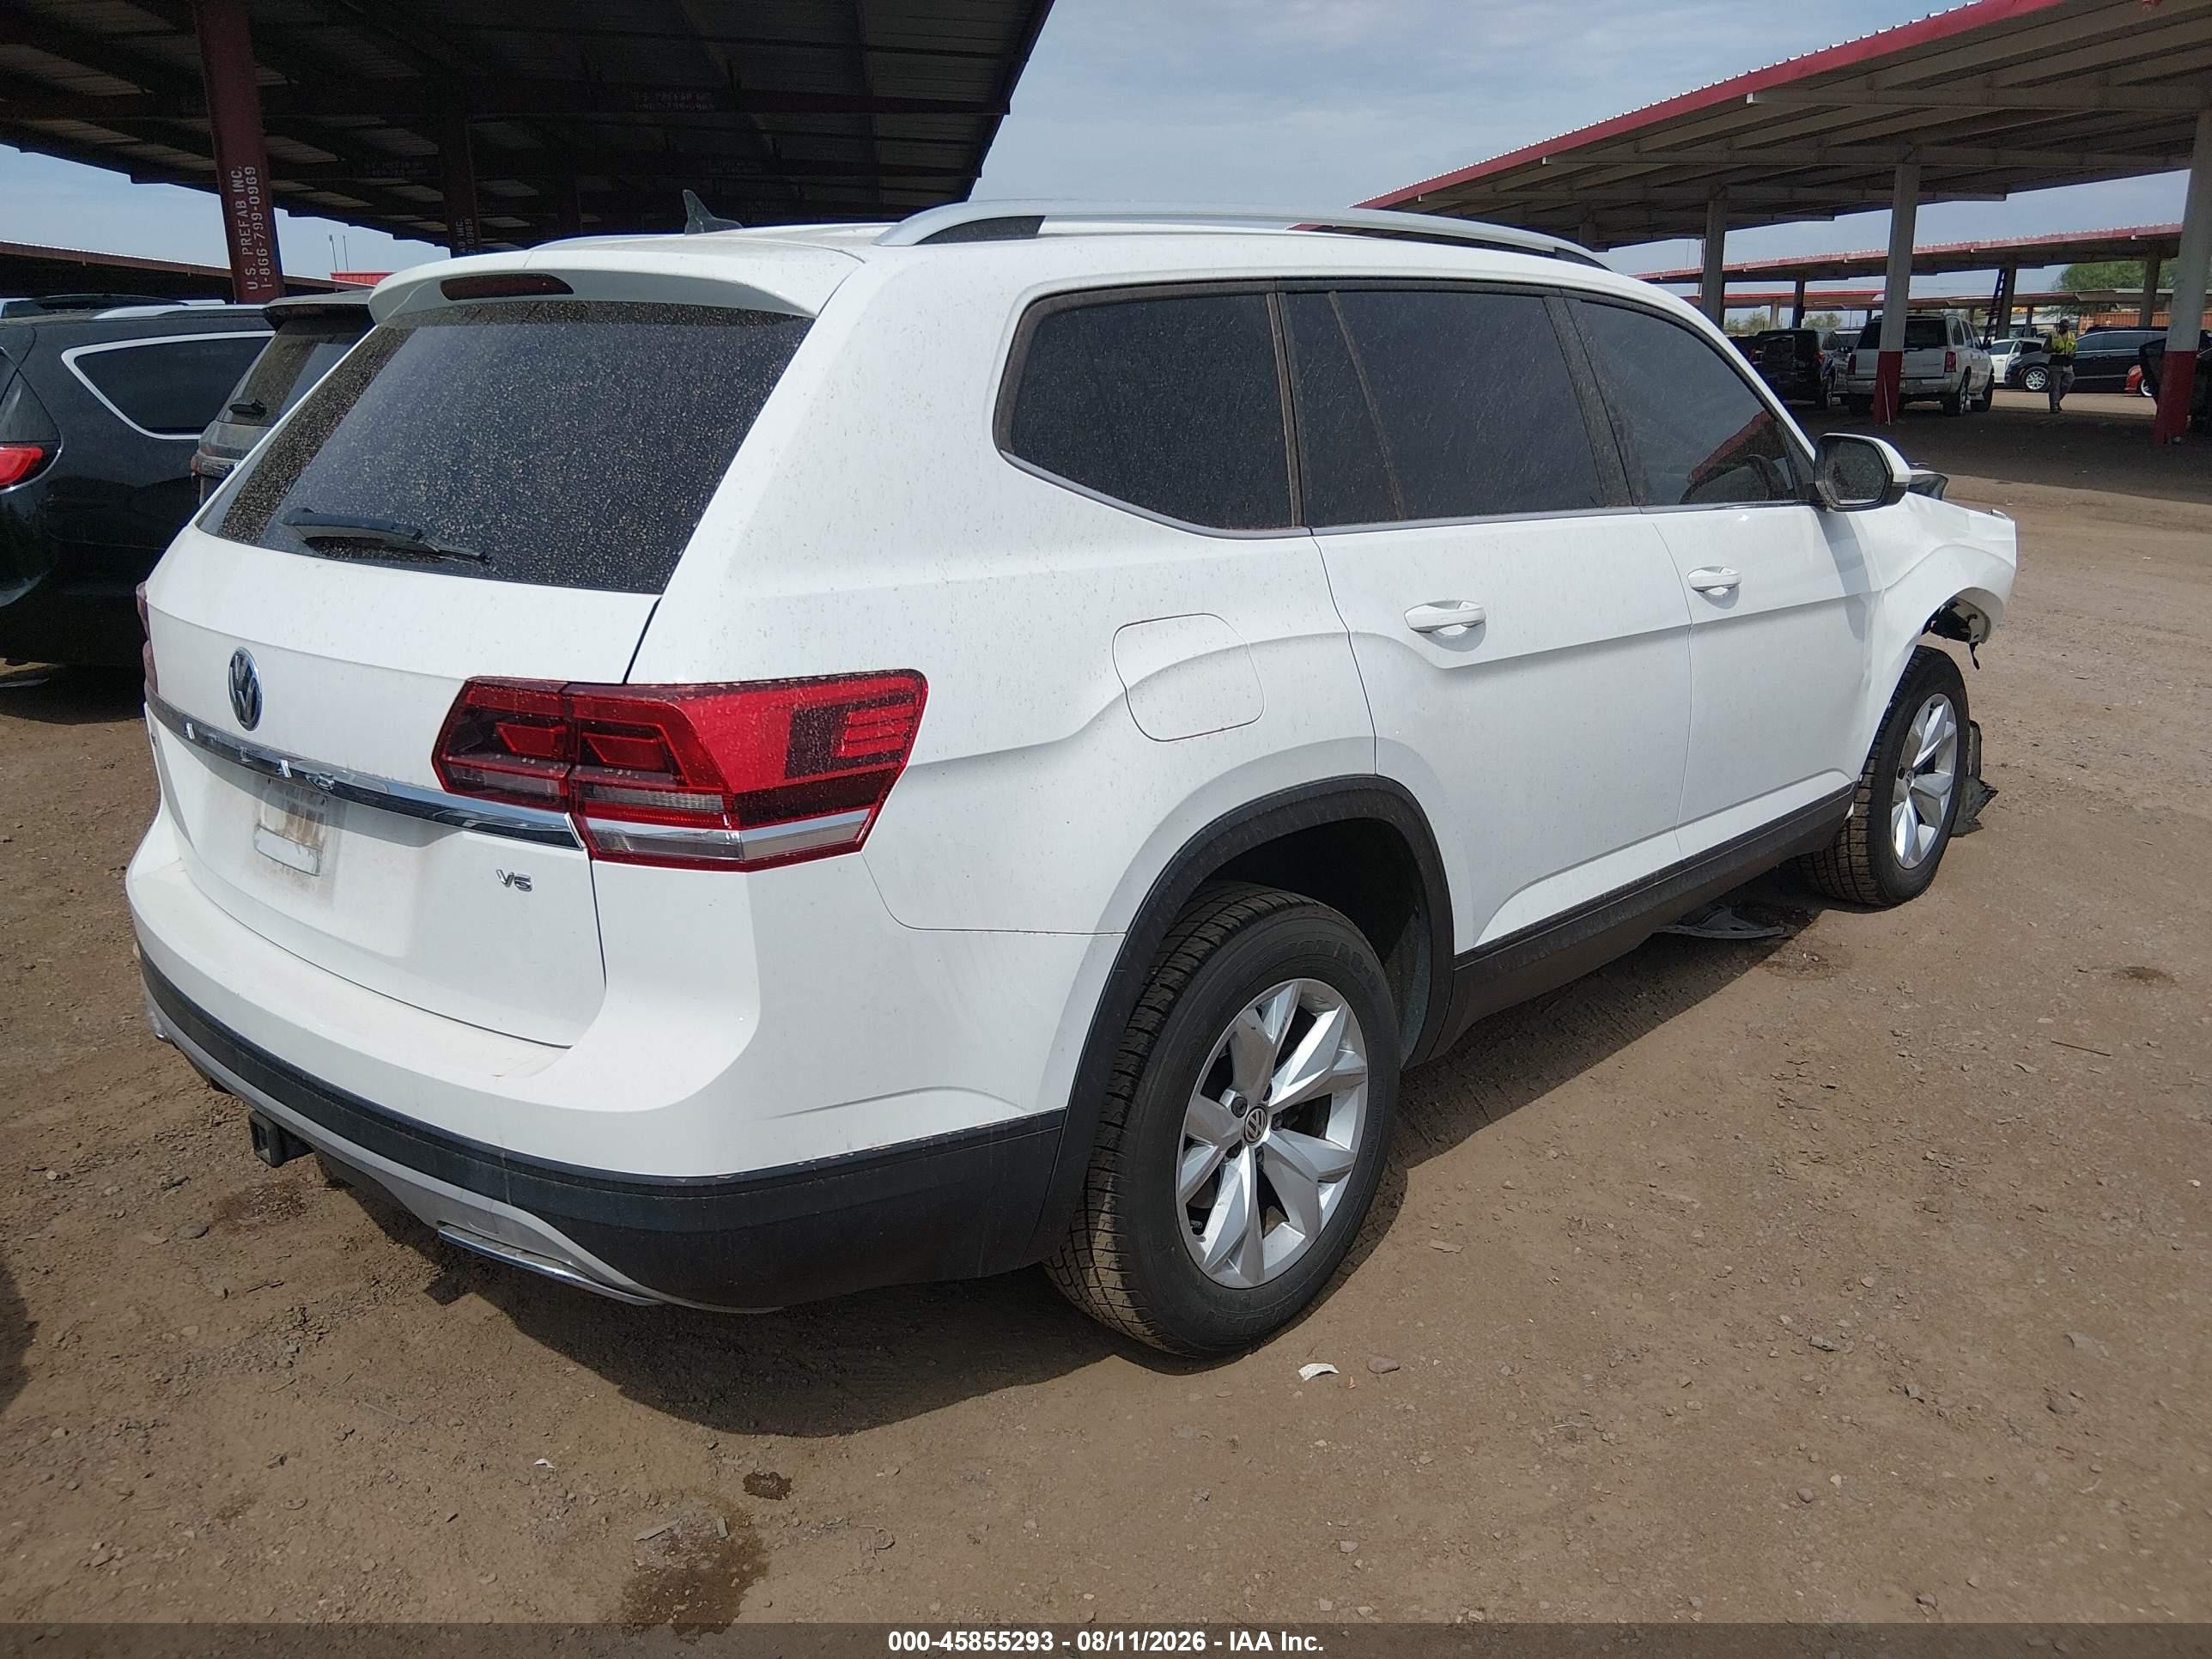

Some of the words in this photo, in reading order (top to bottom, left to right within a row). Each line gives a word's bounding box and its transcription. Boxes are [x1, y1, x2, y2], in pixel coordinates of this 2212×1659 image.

[231, 166, 245, 193] INC.
[235, 200, 253, 255] PREFAB
[244, 167, 273, 288] 1-866-799-0969
[245, 263, 258, 290] U.S.
[495, 869, 532, 892] V6
